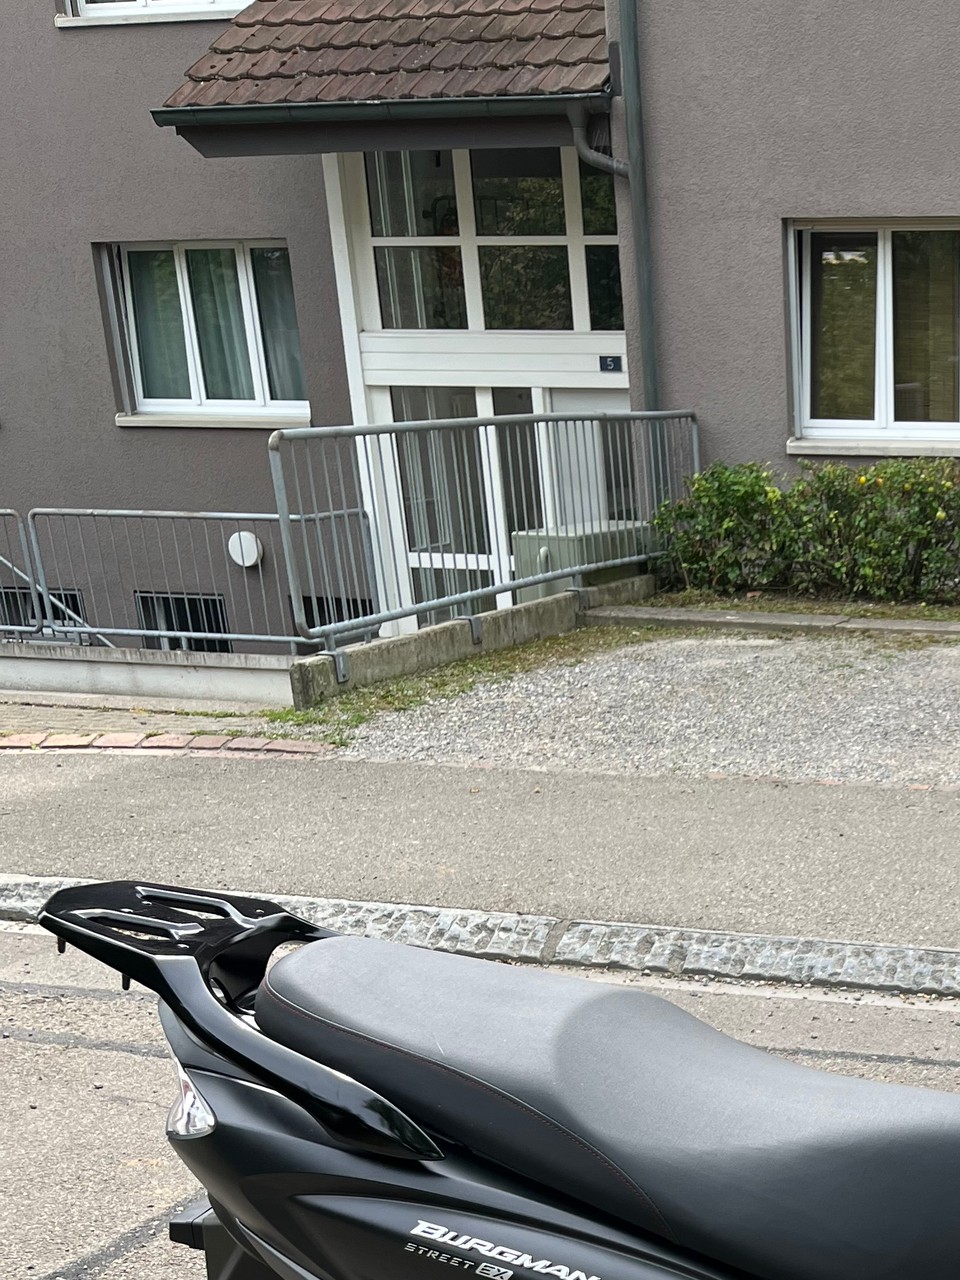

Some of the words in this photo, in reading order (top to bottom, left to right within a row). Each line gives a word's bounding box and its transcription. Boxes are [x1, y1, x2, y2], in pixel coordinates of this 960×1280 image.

[607, 357, 615, 370] 5
[404, 1242, 475, 1270] STREET
[478, 1264, 509, 1280] EX
